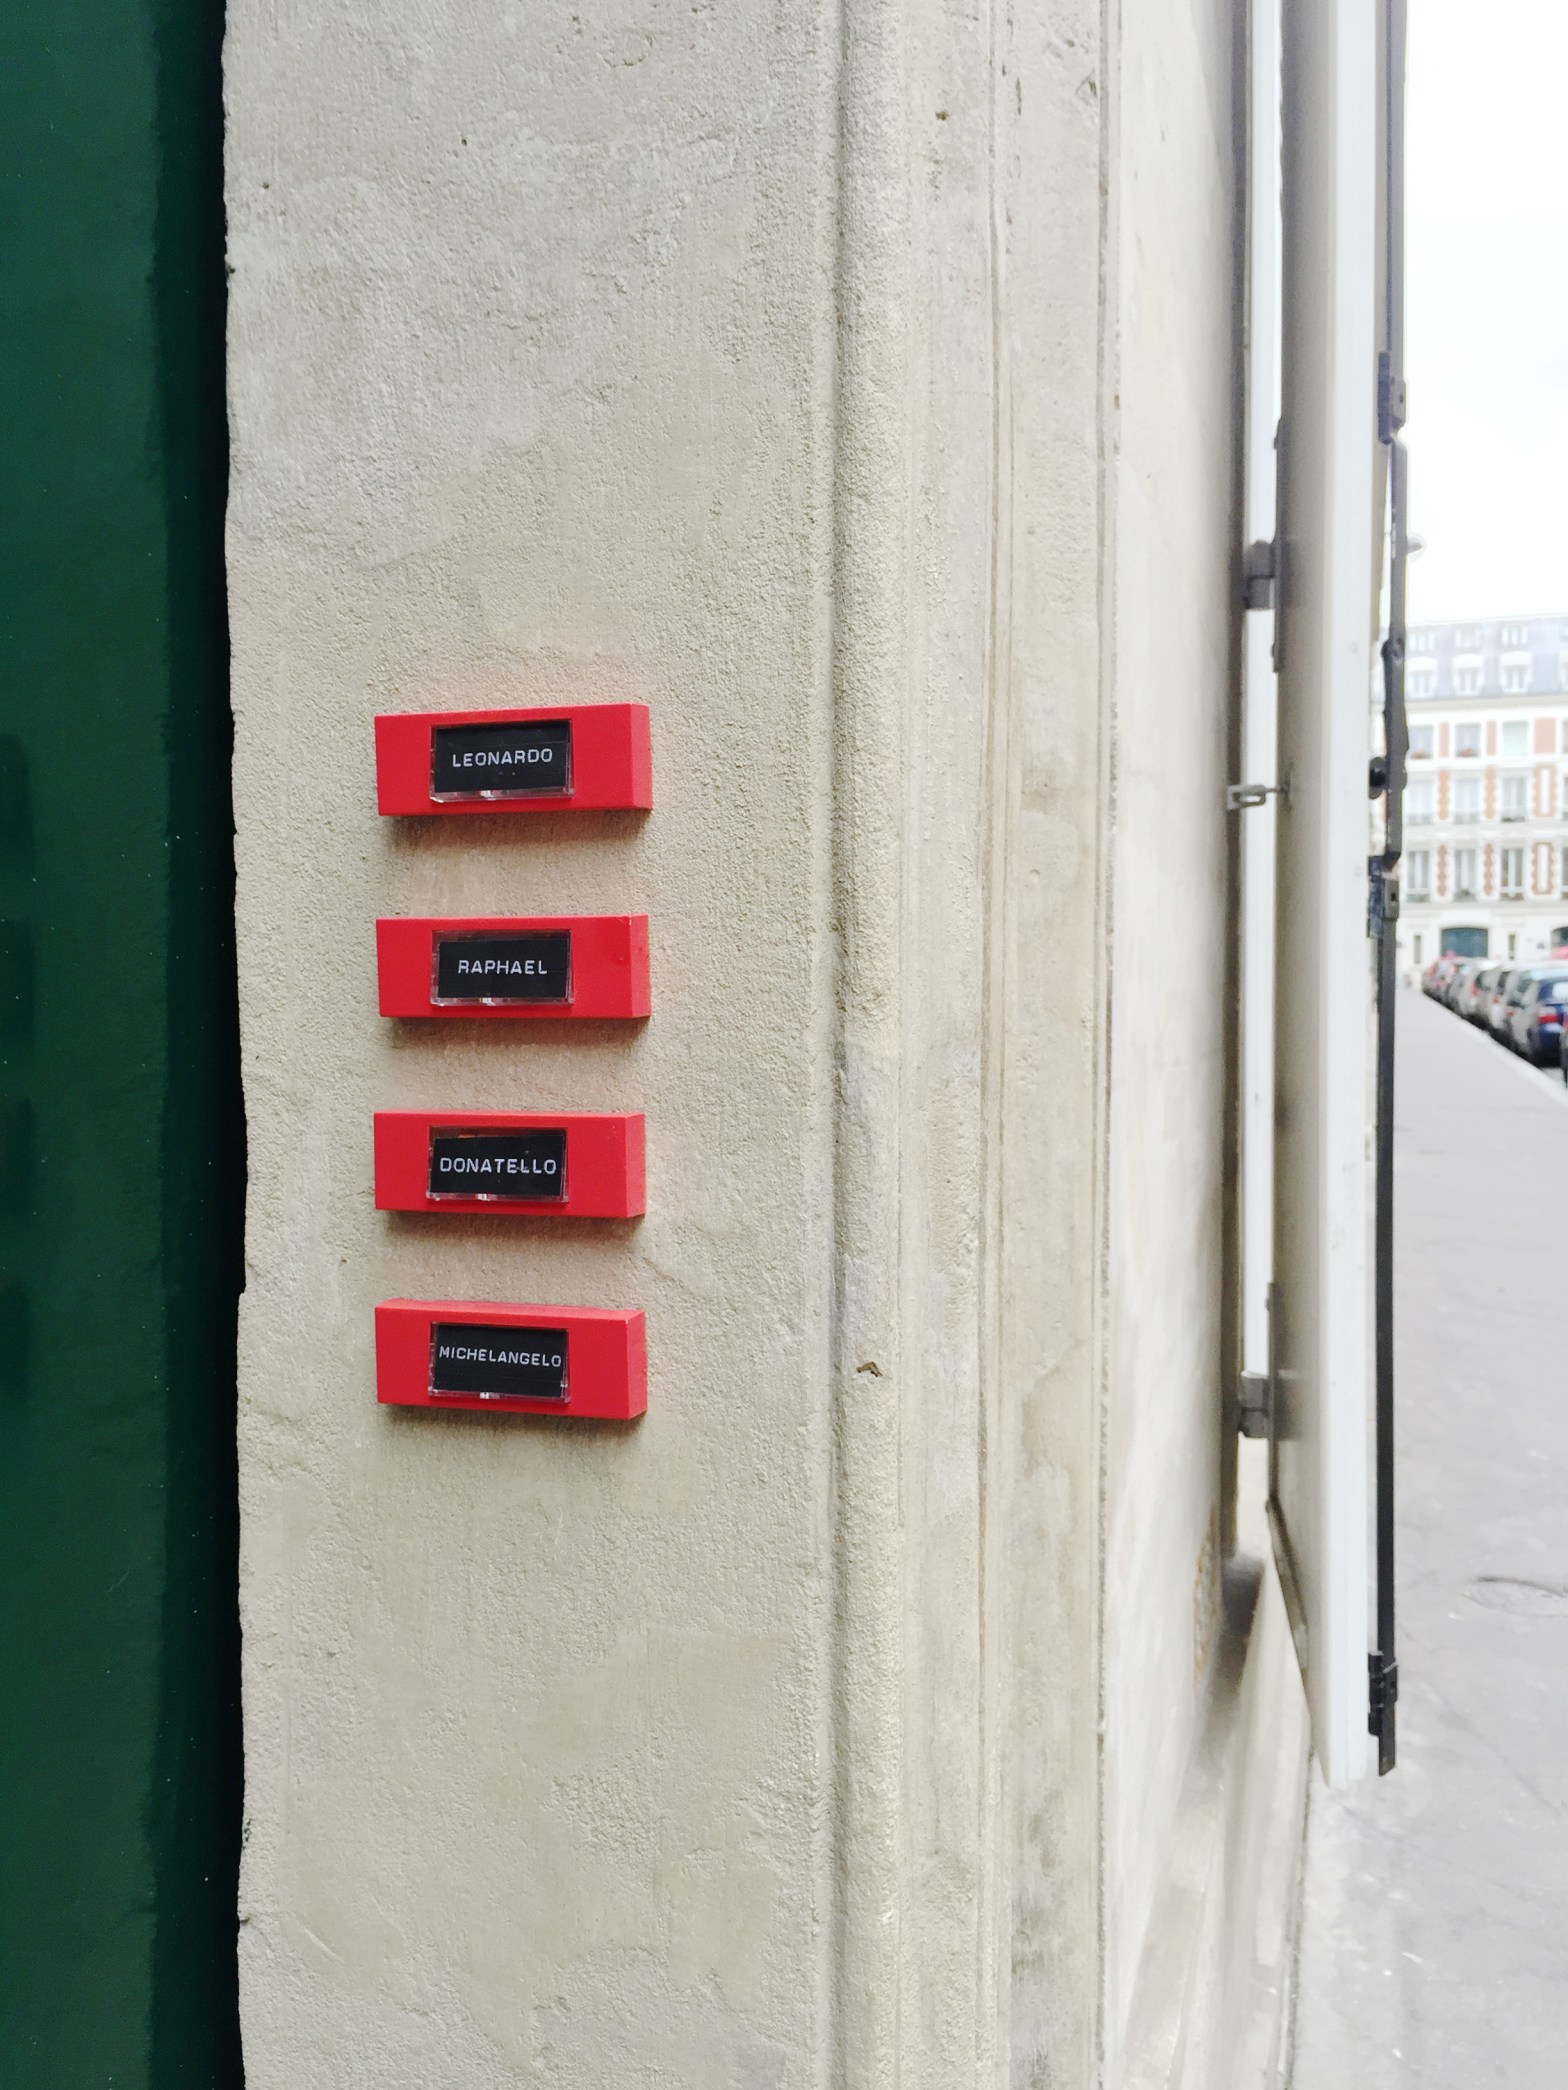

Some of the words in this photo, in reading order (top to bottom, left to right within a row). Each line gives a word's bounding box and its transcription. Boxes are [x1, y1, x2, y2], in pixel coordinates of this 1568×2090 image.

[452, 748, 553, 767] LEONARDO
[457, 959, 548, 975] RAPHAEL
[439, 1157, 557, 1174] DONATELLO
[439, 1346, 562, 1367] MICHELANGELO
